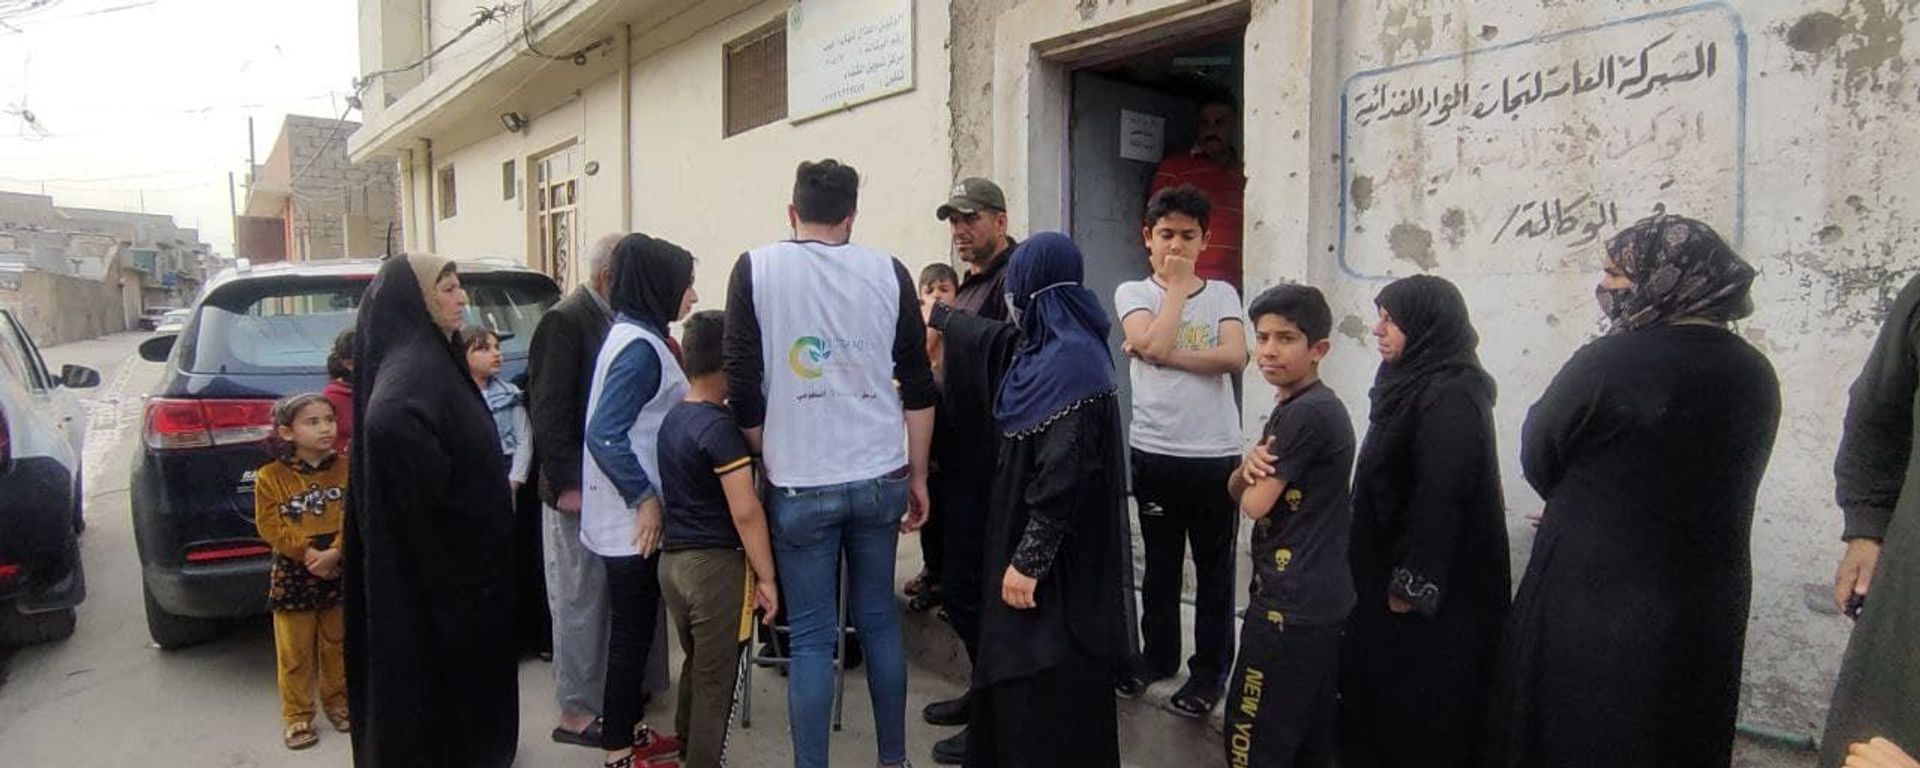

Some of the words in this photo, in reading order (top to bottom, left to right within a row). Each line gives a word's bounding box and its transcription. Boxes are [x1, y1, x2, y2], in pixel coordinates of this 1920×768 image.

[1616, 32, 1716, 100] الشركة
[1418, 83, 1469, 126] المواد
[1240, 666, 1264, 718] NEW
[1231, 723, 1253, 768] YOR
